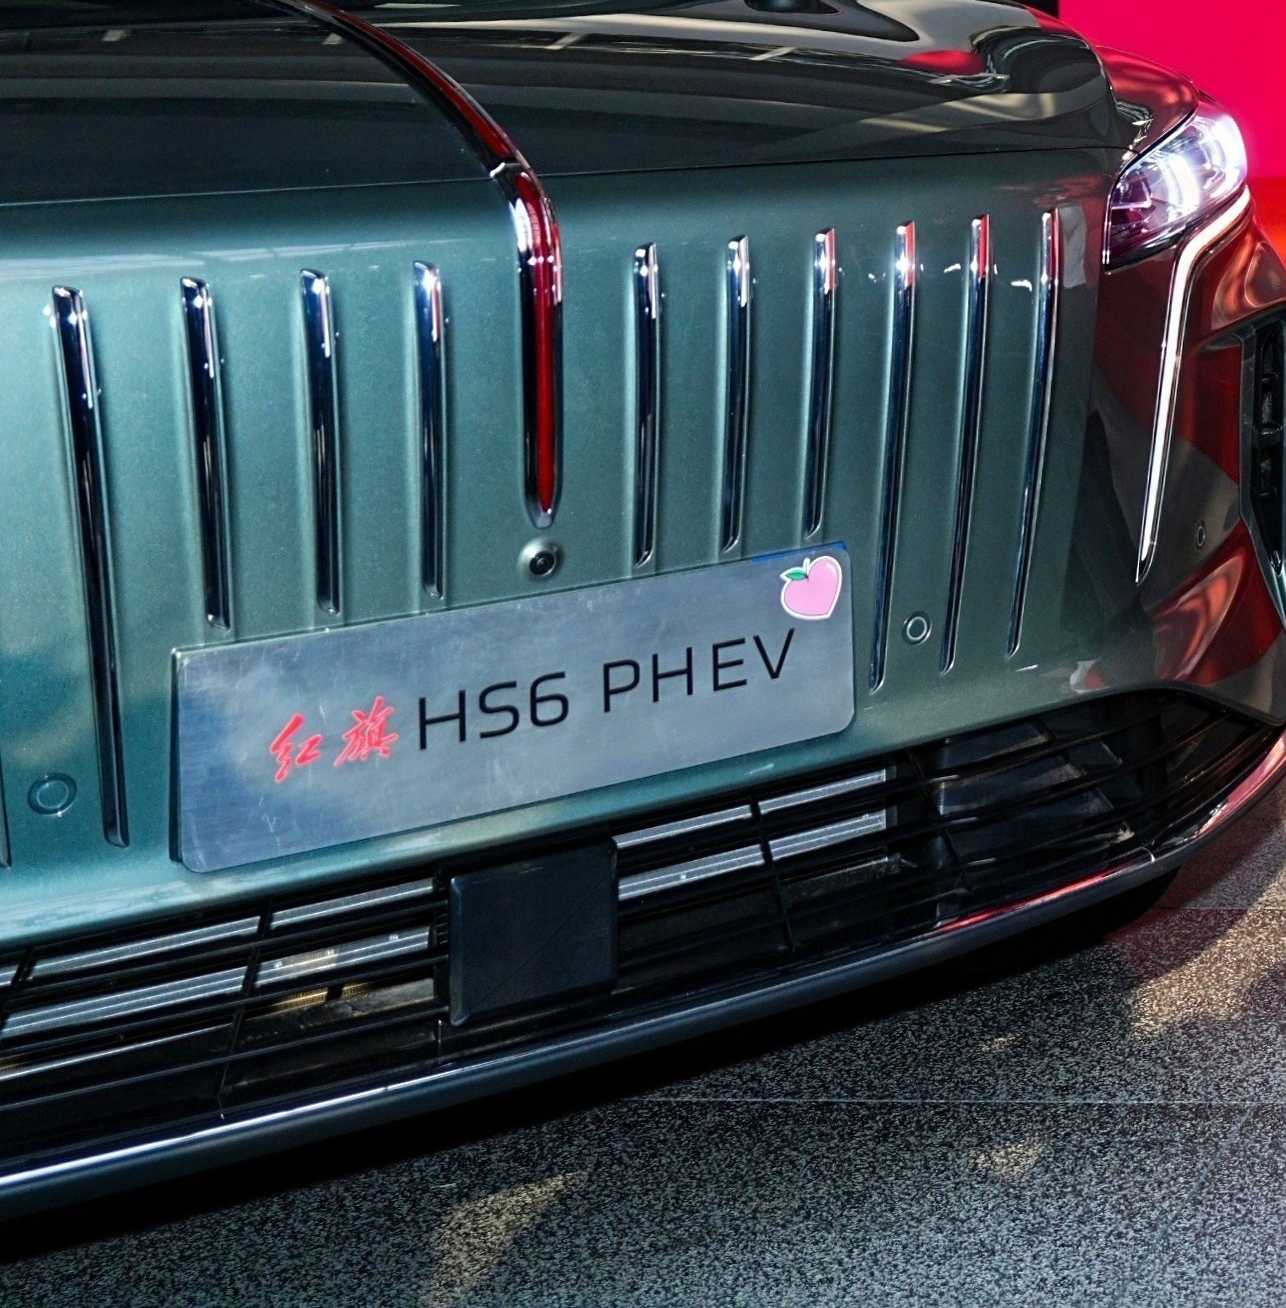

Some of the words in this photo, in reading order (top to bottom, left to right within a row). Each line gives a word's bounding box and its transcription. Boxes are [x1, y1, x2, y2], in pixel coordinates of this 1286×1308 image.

[269, 695, 398, 783] 红旗
[417, 671, 570, 750] HS6
[602, 628, 796, 713] PHEV
